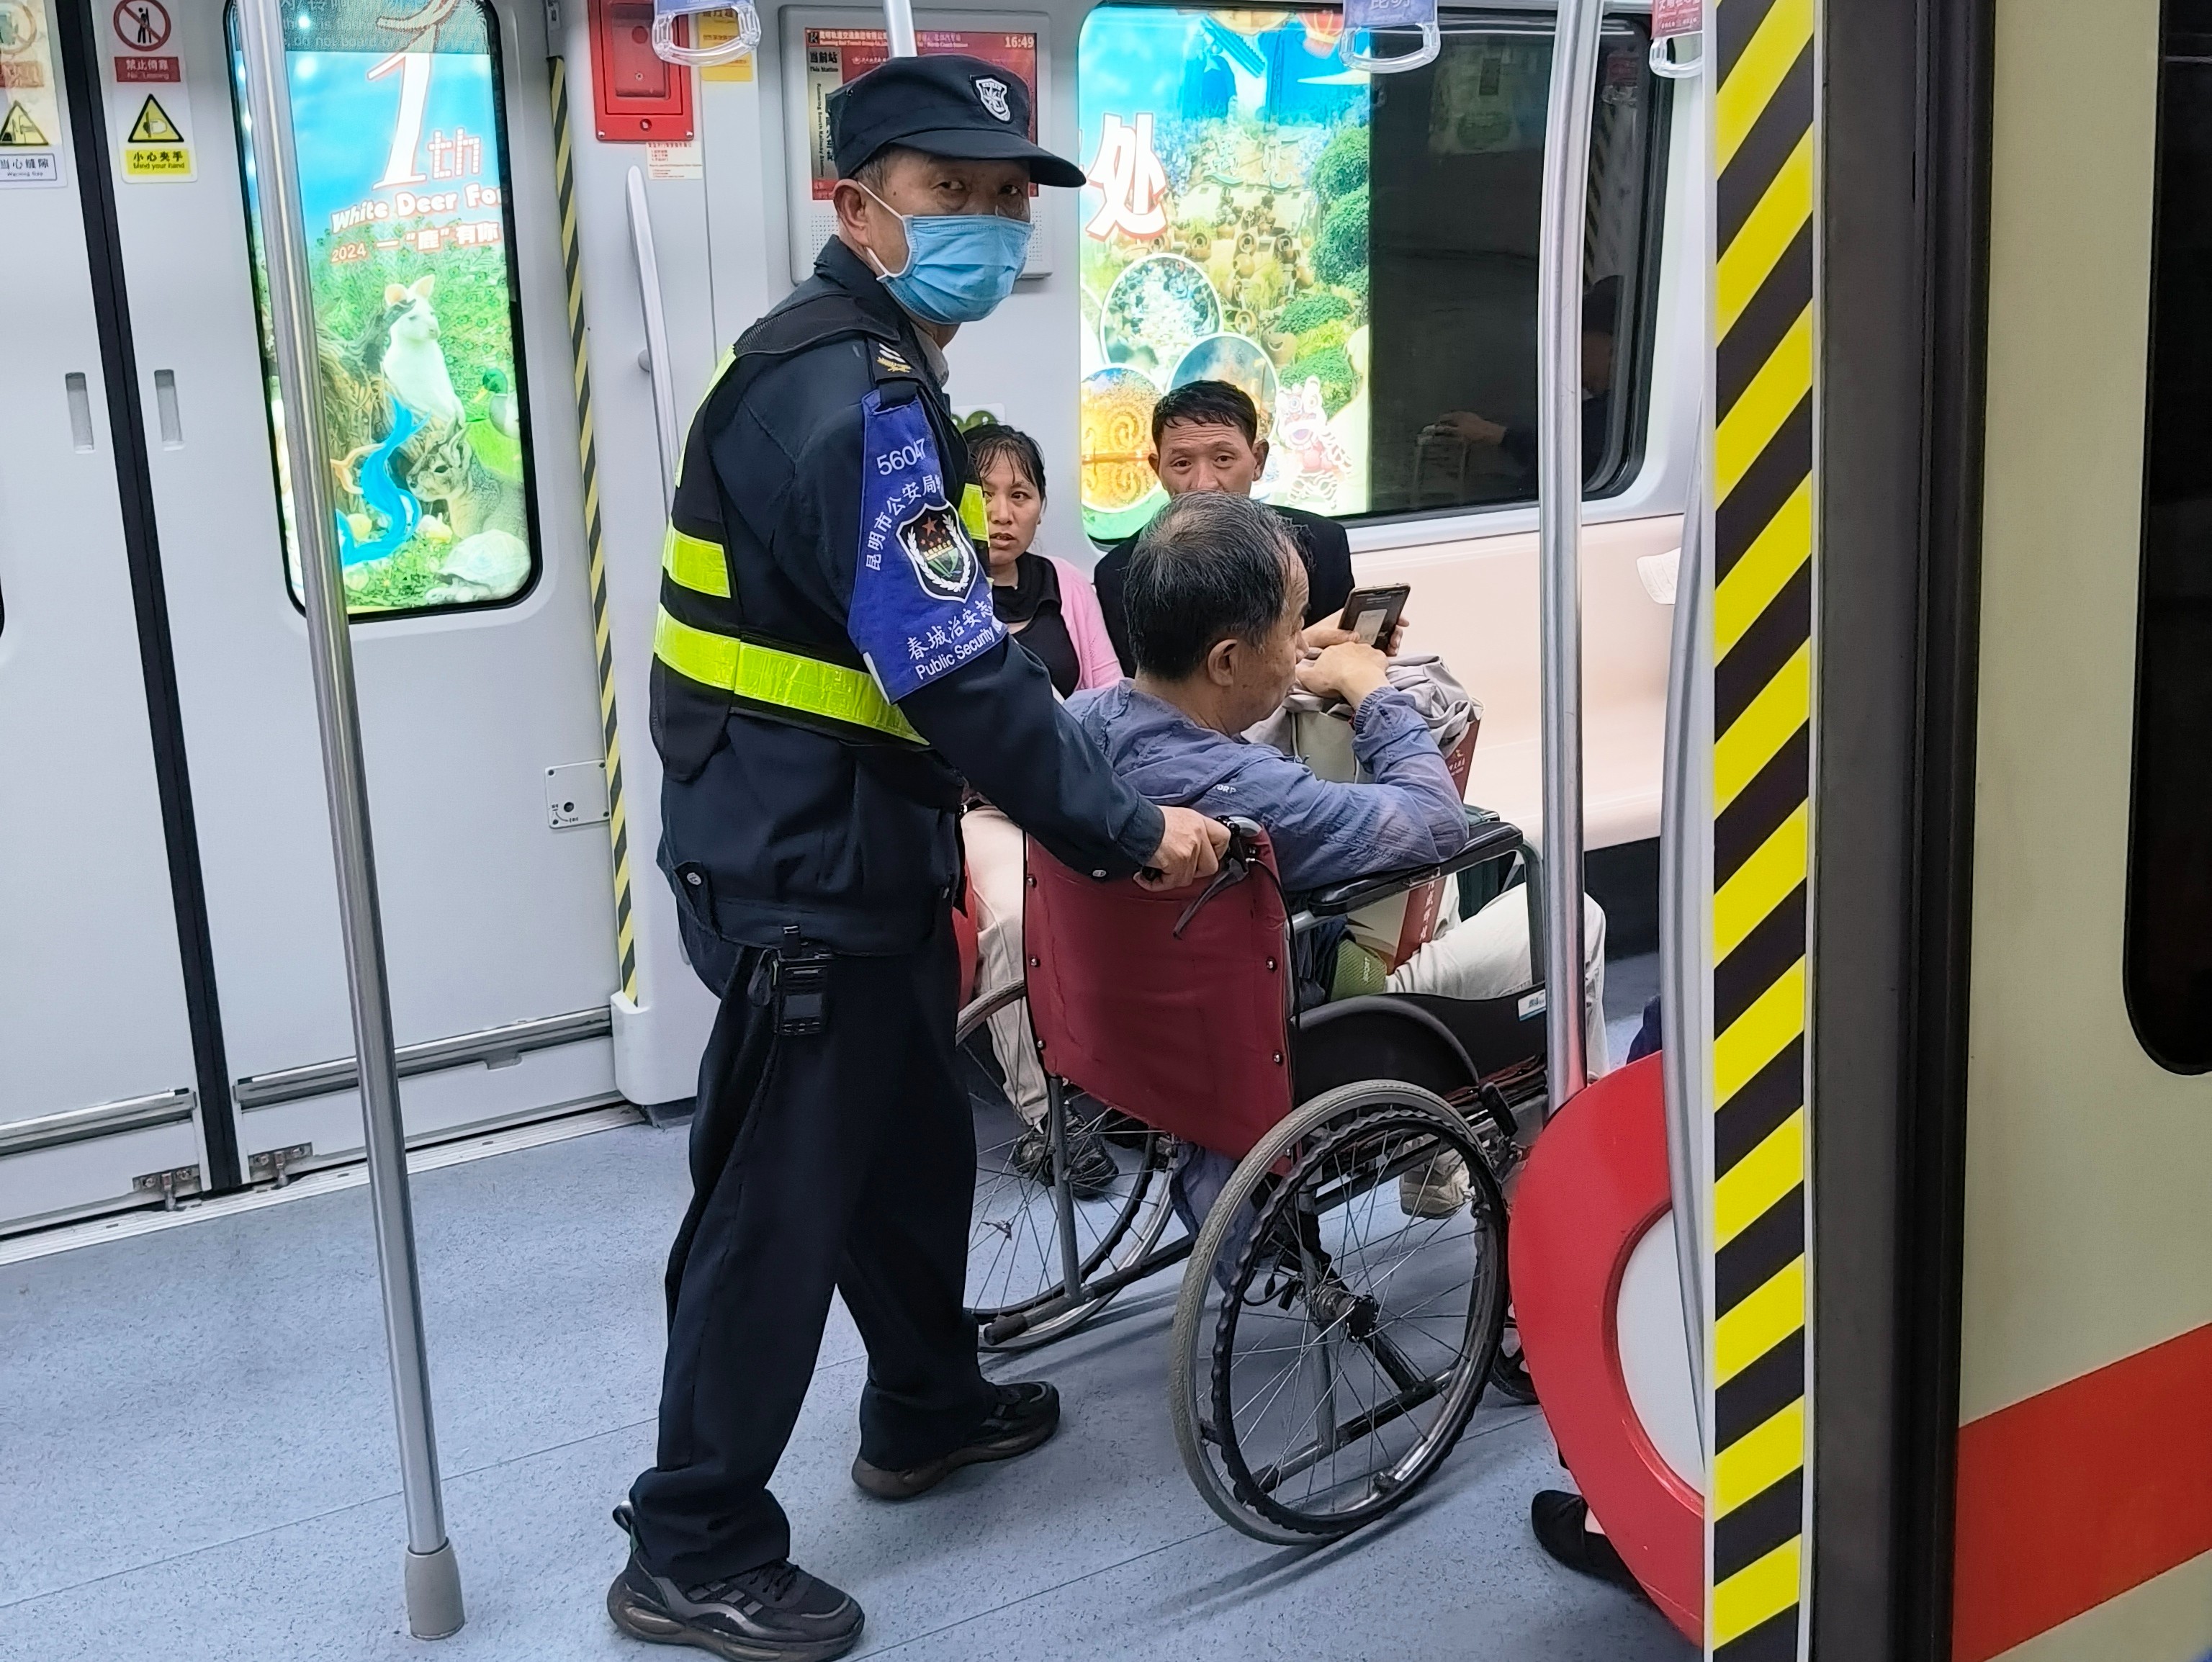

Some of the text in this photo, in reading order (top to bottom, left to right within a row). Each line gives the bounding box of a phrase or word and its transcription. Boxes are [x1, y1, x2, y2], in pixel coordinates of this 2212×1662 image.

[1005, 36, 1035, 48] 16:49
[133, 151, 183, 162] 小心夹手
[331, 199, 390, 235] White
[395, 192, 458, 218] Deer
[331, 243, 367, 264] 2024
[876, 437, 926, 476] 56047
[907, 592, 993, 661] 春城治安志
[915, 626, 996, 680] Public Security
